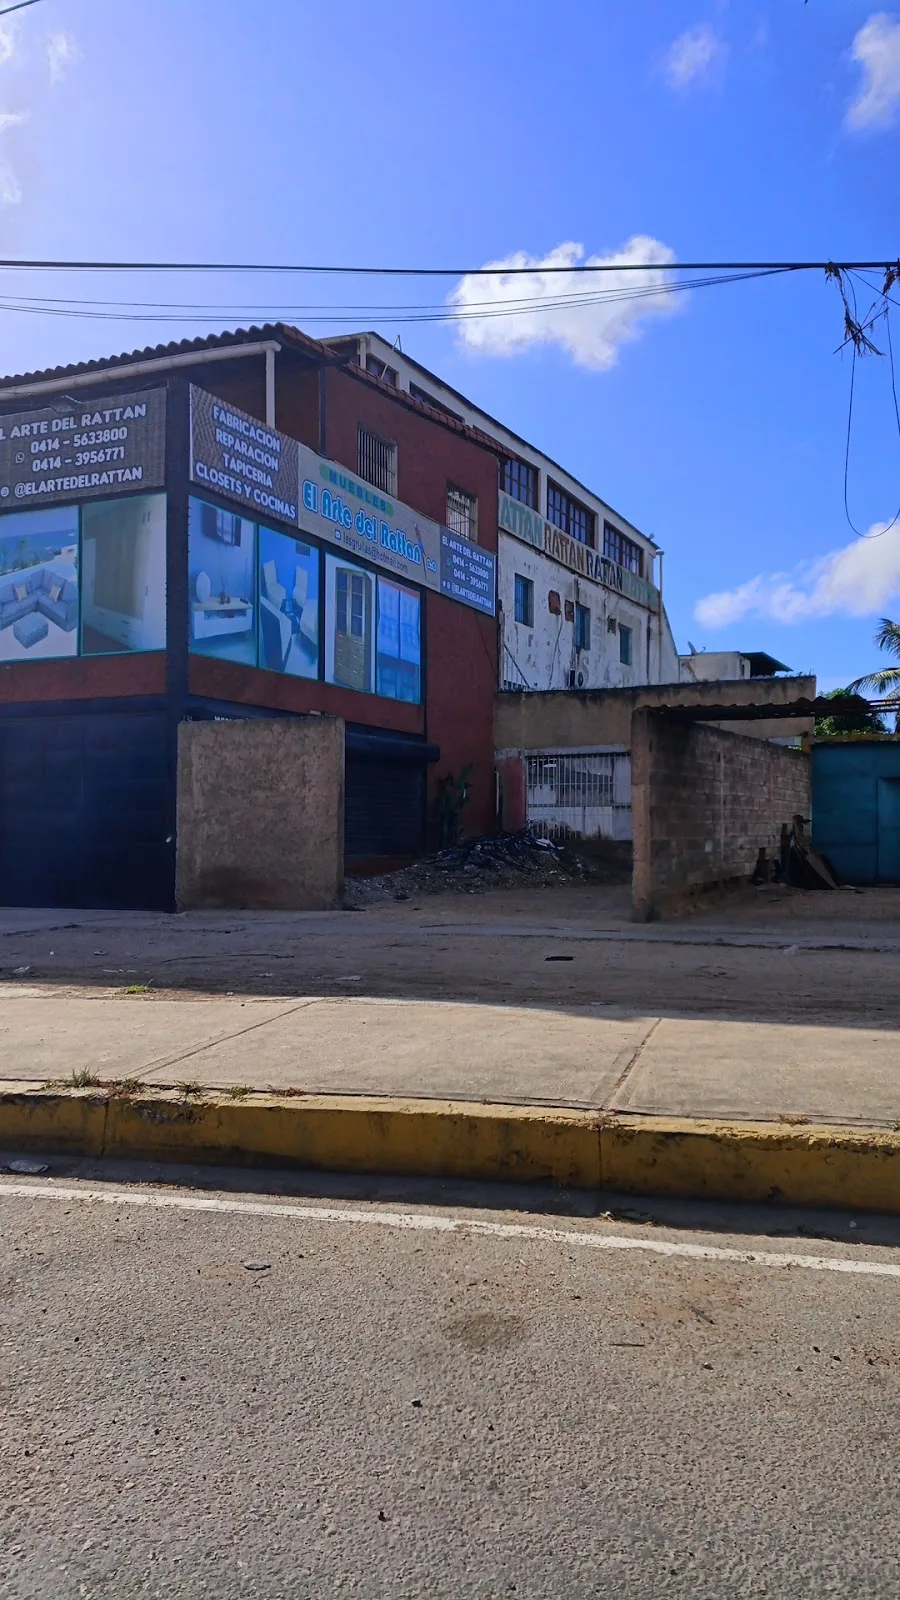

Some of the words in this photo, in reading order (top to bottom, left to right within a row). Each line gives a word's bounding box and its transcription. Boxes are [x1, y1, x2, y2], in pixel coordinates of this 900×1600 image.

[10, 421, 48, 438] ARTE
[52, 417, 77, 432] DEL
[81, 403, 147, 426] RATTAN
[213, 405, 280, 452] FABRICACION
[30, 438, 60, 453] 0414
[73, 427, 128, 447] 5633800
[215, 428, 278, 471] REPARACION
[32, 457, 62, 472] 0414
[75, 446, 125, 466] 3956771
[222, 453, 273, 488] TAPICERIA
[14, 466, 143, 498] @ELARTEDELRATTAN
[196, 462, 242, 495] CLOSETS
[244, 484, 252, 498] Y
[253, 489, 296, 519] COCINAS
[329, 469, 386, 512] MUEBLES
[303, 480, 318, 513] El
[321, 489, 353, 529] Arte
[355, 509, 378, 543] del
[380, 521, 422, 565] Rattan
[442, 535, 449, 546] EL
[449, 540, 463, 554] ARTE
[463, 548, 472, 559] DEL
[472, 552, 493, 569] RATTAN
[452, 554, 465, 567] 0414
[544, 522, 585, 572] RATTAN
[586, 549, 623, 592] RATTAN
[453, 569, 466, 581] 0414
